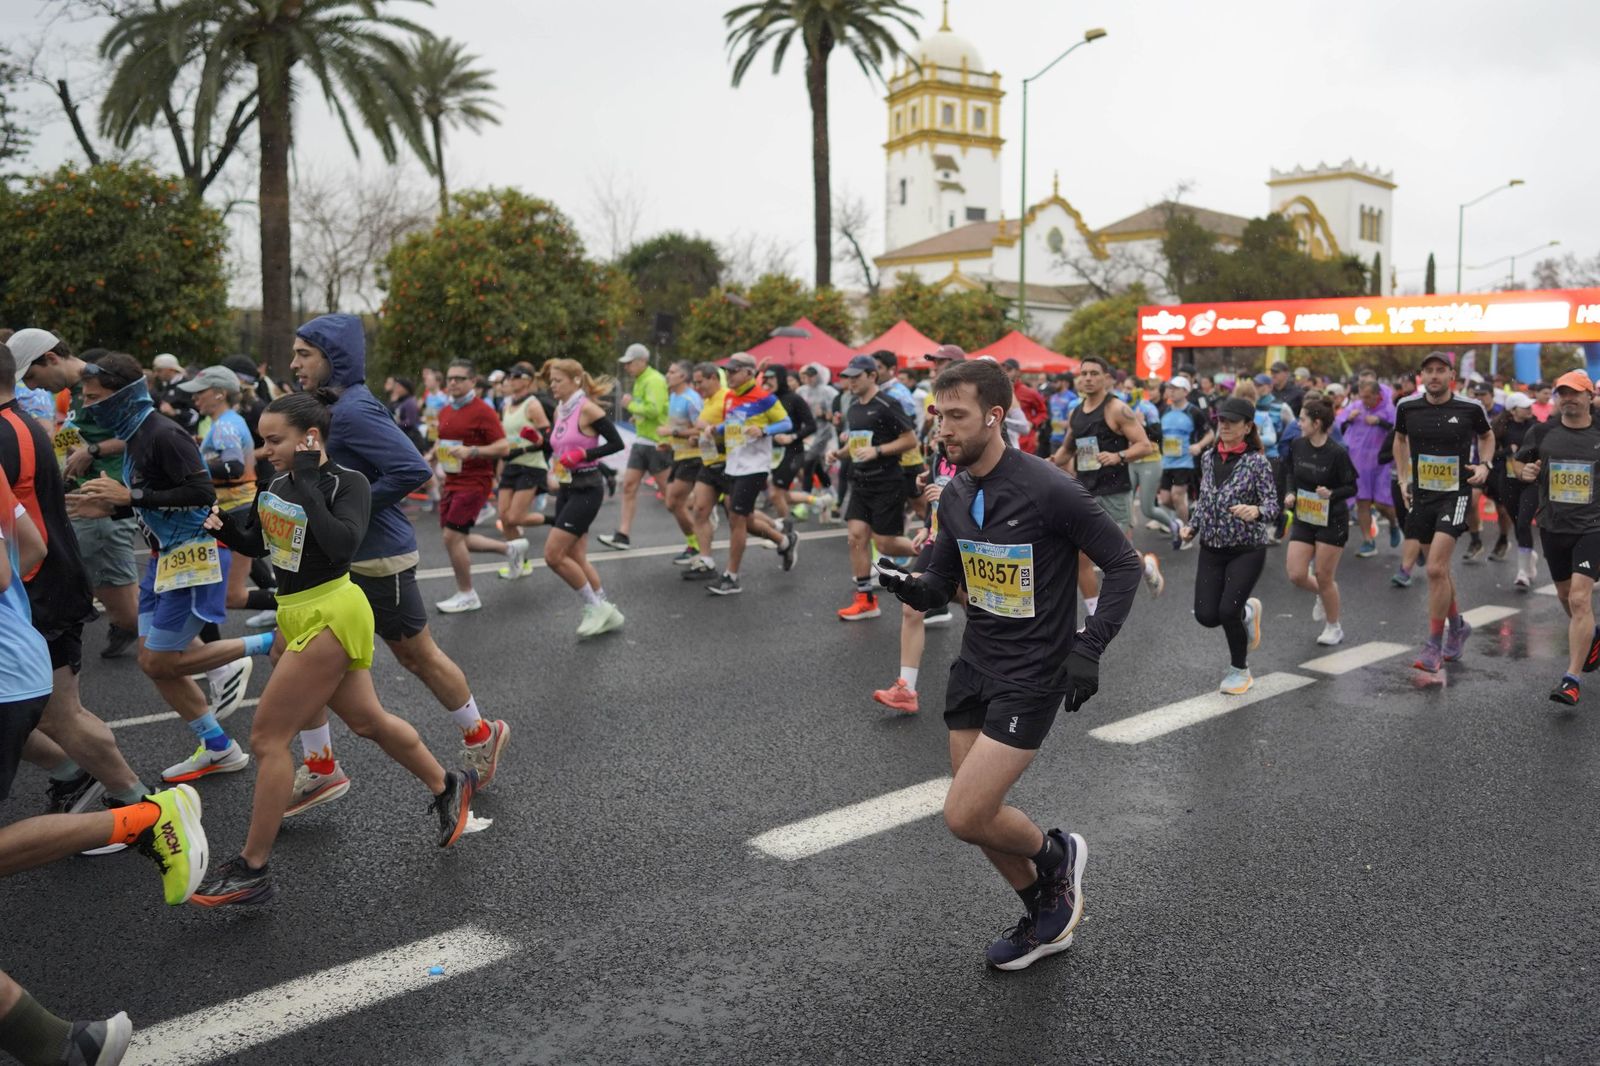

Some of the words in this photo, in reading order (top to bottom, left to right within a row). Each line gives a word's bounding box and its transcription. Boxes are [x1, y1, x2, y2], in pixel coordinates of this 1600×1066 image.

[1421, 464, 1452, 477] 17021
[1553, 473, 1590, 487] 13886
[162, 546, 208, 571] 13918
[968, 556, 1019, 585] 18357
[1009, 716, 1019, 733] FILA
[161, 820, 183, 856] HOKA
